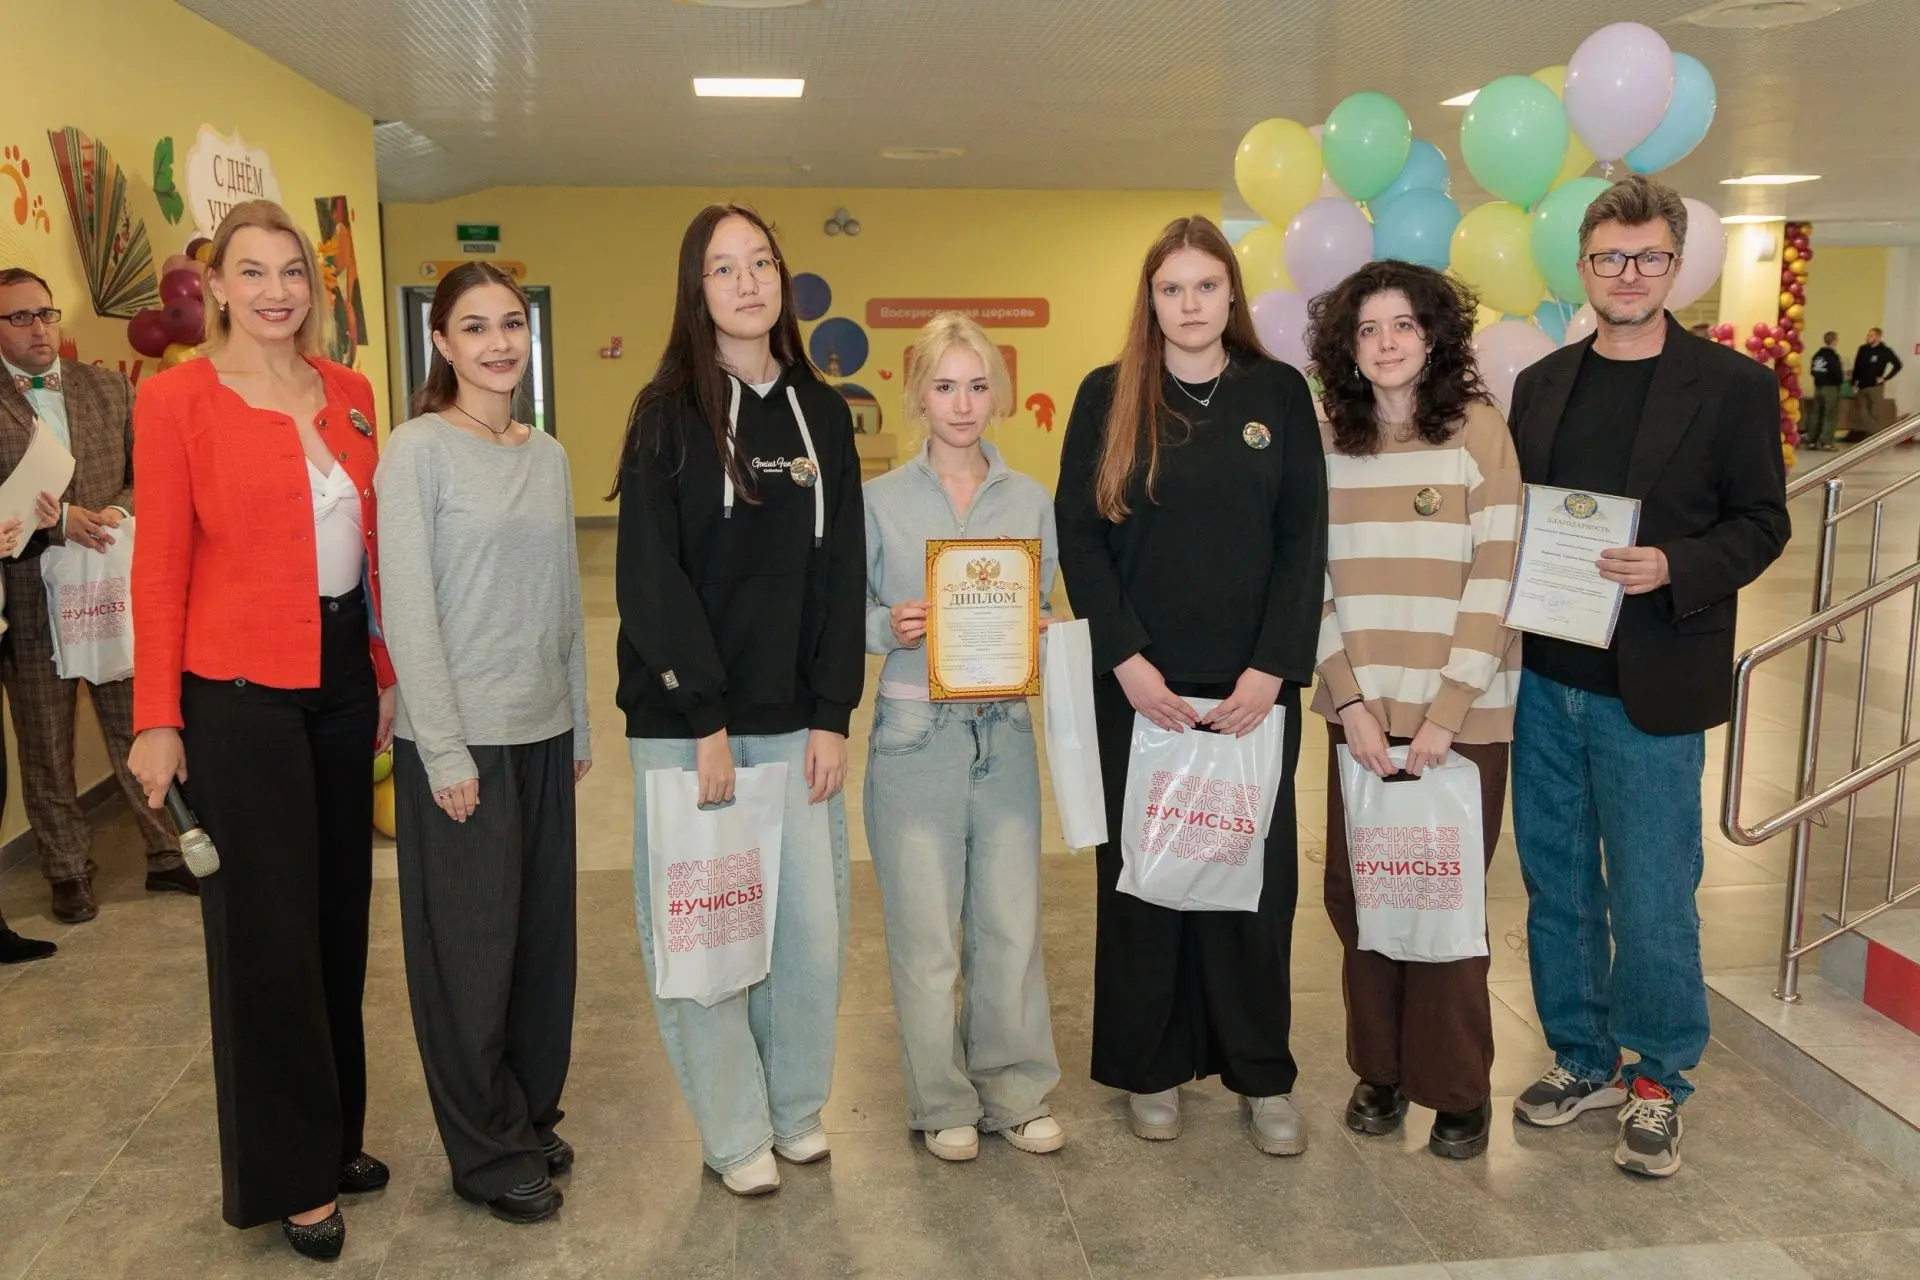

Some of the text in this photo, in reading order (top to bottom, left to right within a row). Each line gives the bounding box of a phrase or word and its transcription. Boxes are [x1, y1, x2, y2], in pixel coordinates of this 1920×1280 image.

[213, 154, 264, 199] С ДНЁМ
[880, 307, 1035, 320] Воскресеая церковь
[1547, 517, 1610, 533] БЛАГОДАРНОСТЬ
[950, 592, 1016, 606] ДИПЛОМ
[1146, 804, 1255, 834] #УЧИСЬ33
[1354, 827, 1459, 843] #УЧИСЬ33
[1355, 844, 1460, 860] #УЧИСЬ33
[668, 848, 760, 879] #УЧИСЬ33
[1356, 860, 1461, 876] #УЧИСЬ33
[668, 866, 760, 898] #УЧИСЬ33
[1357, 877, 1462, 893] #УЧИСЬ33
[669, 884, 763, 915] #УЧИСЬ33
[1358, 893, 1463, 910] #УЧИСЬ33
[668, 901, 763, 934] #УЧИСЬ33
[668, 919, 764, 952] #УЧИСЬ33
